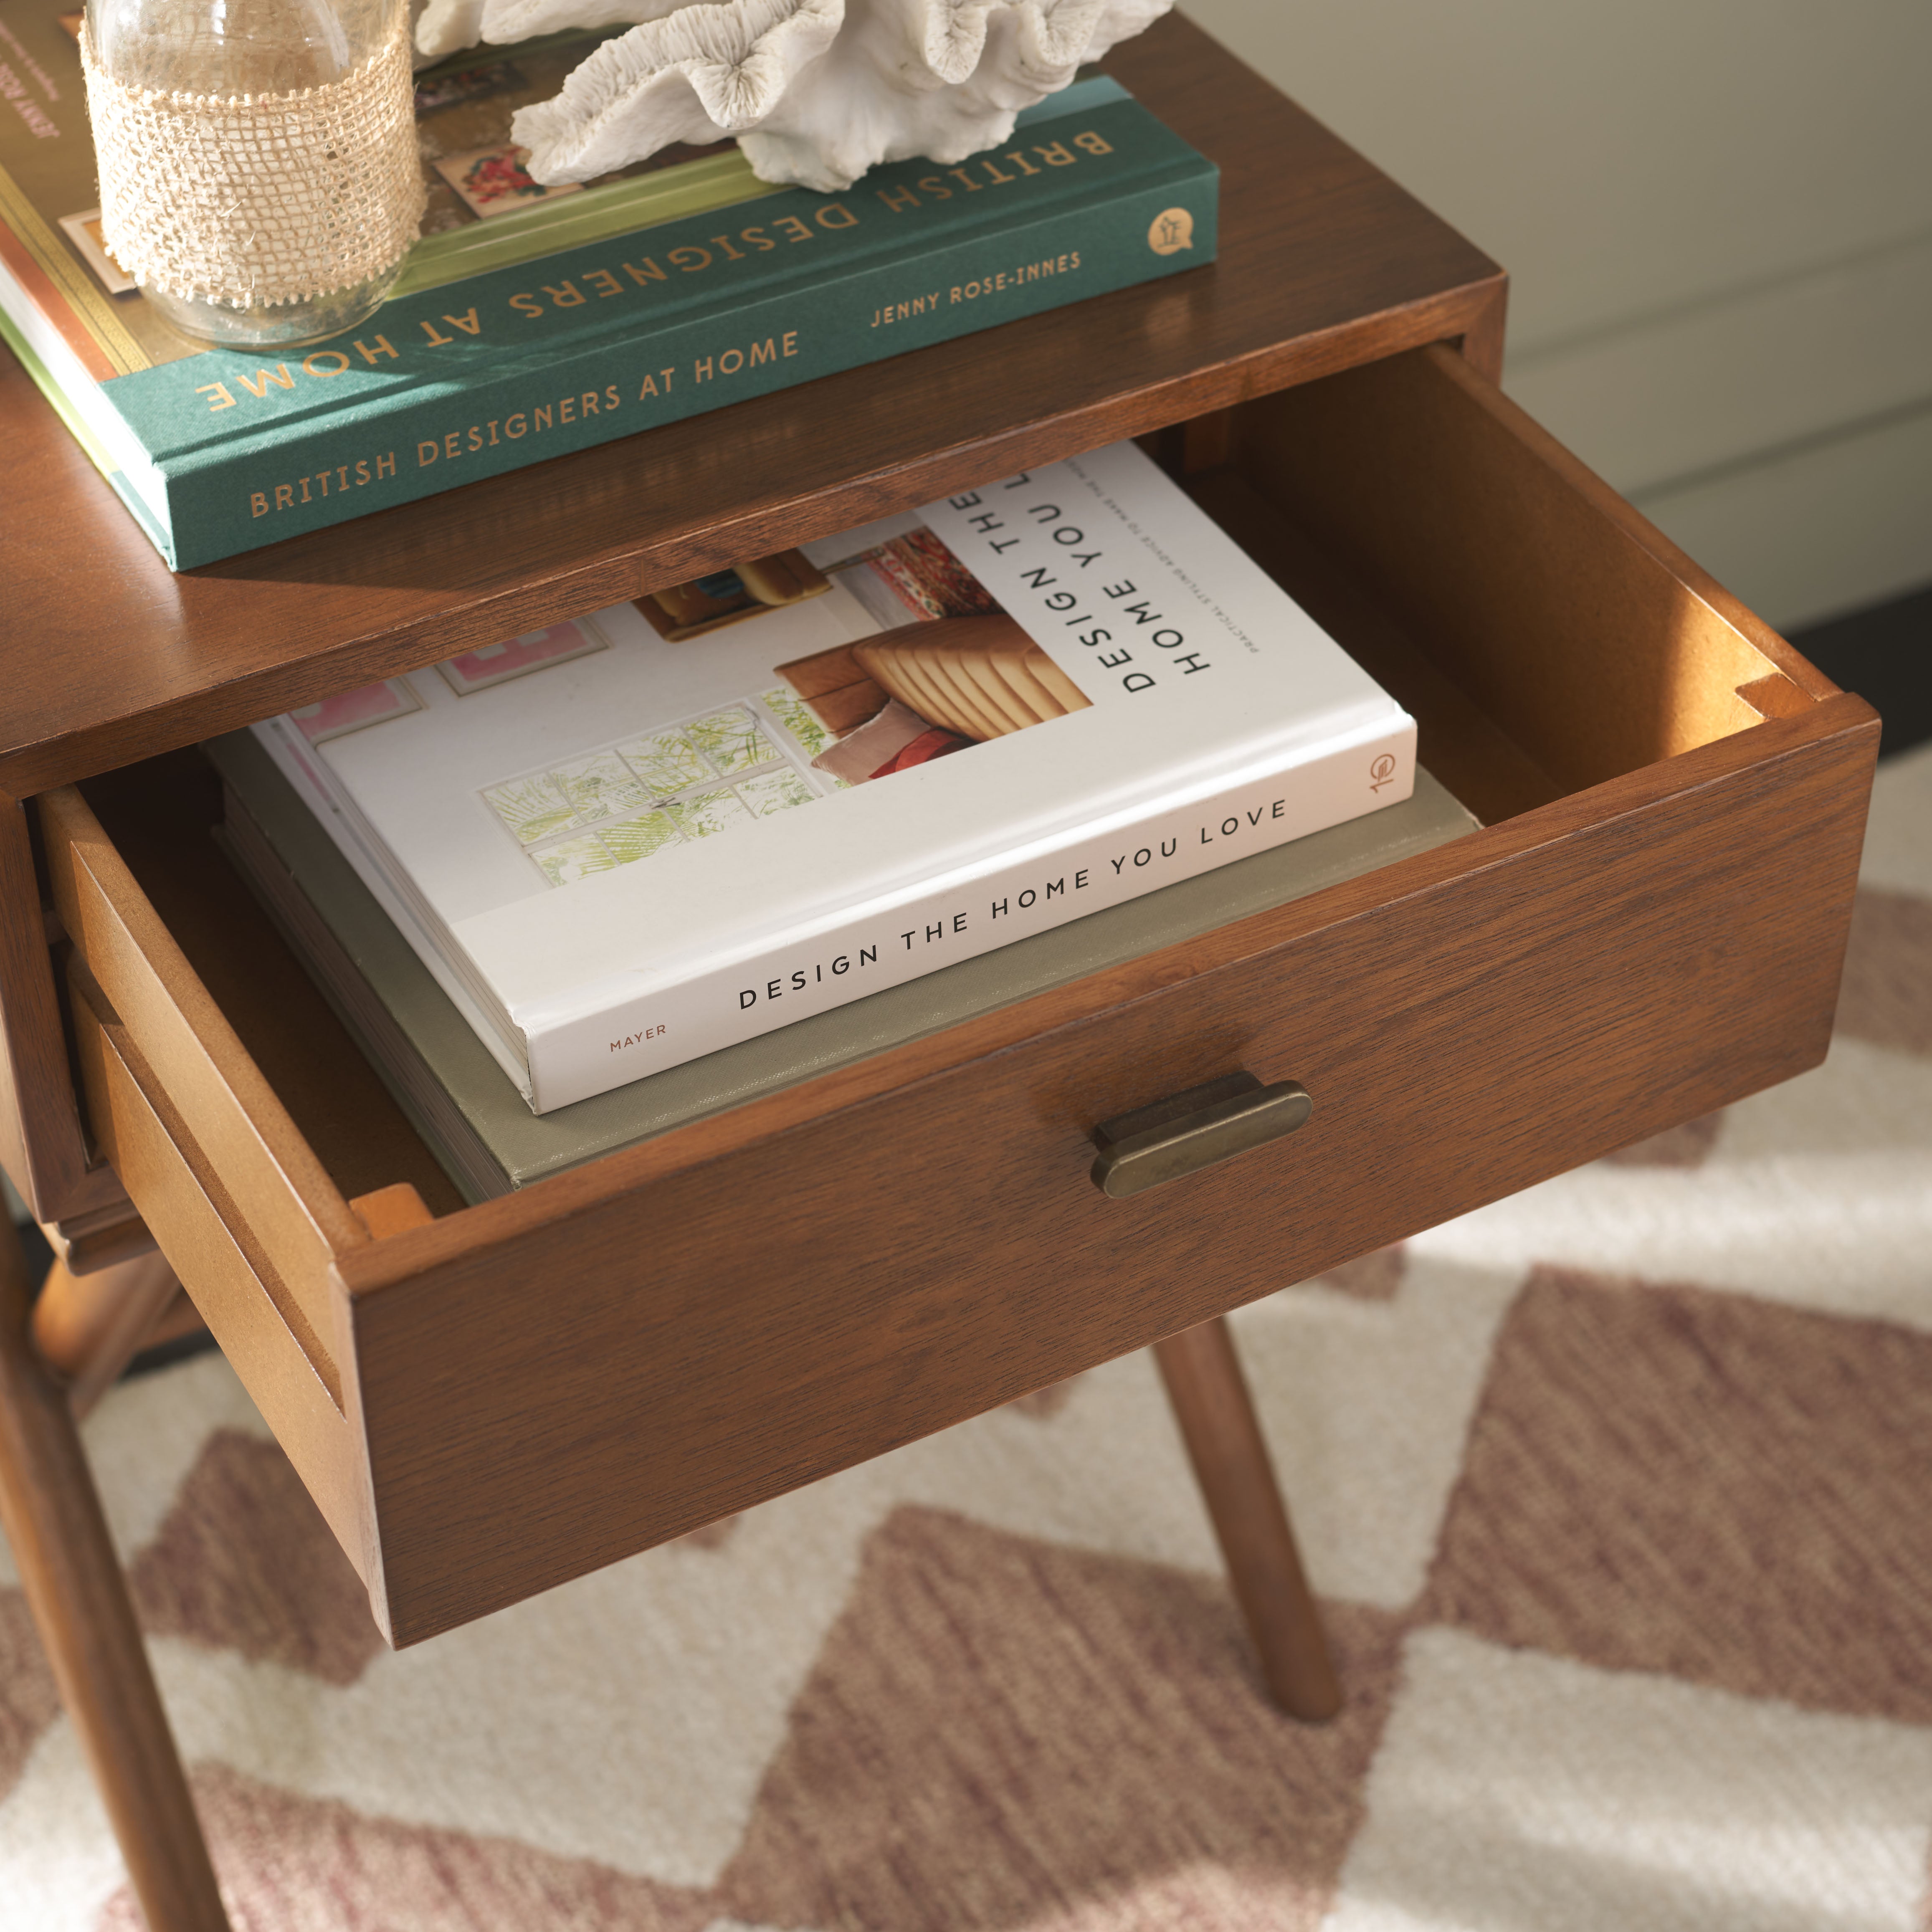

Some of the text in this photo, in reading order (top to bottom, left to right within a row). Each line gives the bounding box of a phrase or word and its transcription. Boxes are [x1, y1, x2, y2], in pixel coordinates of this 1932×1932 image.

[195, 131, 1114, 412] BRITISH DESIGNERS AT HOME
[871, 252, 1081, 328] JENNY ROSE-INNES
[251, 331, 799, 518] BRITISH DESIGNERS AT HOME
[1027, 504, 1102, 568] YOU
[1102, 498, 1129, 522] MAKE
[1127, 522, 1142, 535] TO
[1141, 537, 1174, 566] ADVICE
[1172, 568, 1211, 605] STYLING
[948, 491, 1156, 693] DESIGN THE
[1102, 580, 1211, 675] HOME
[1211, 605, 1260, 653] PRACTICAL
[610, 799, 1286, 1052] MAYER DESIGN THE HOME YOU LOVE
